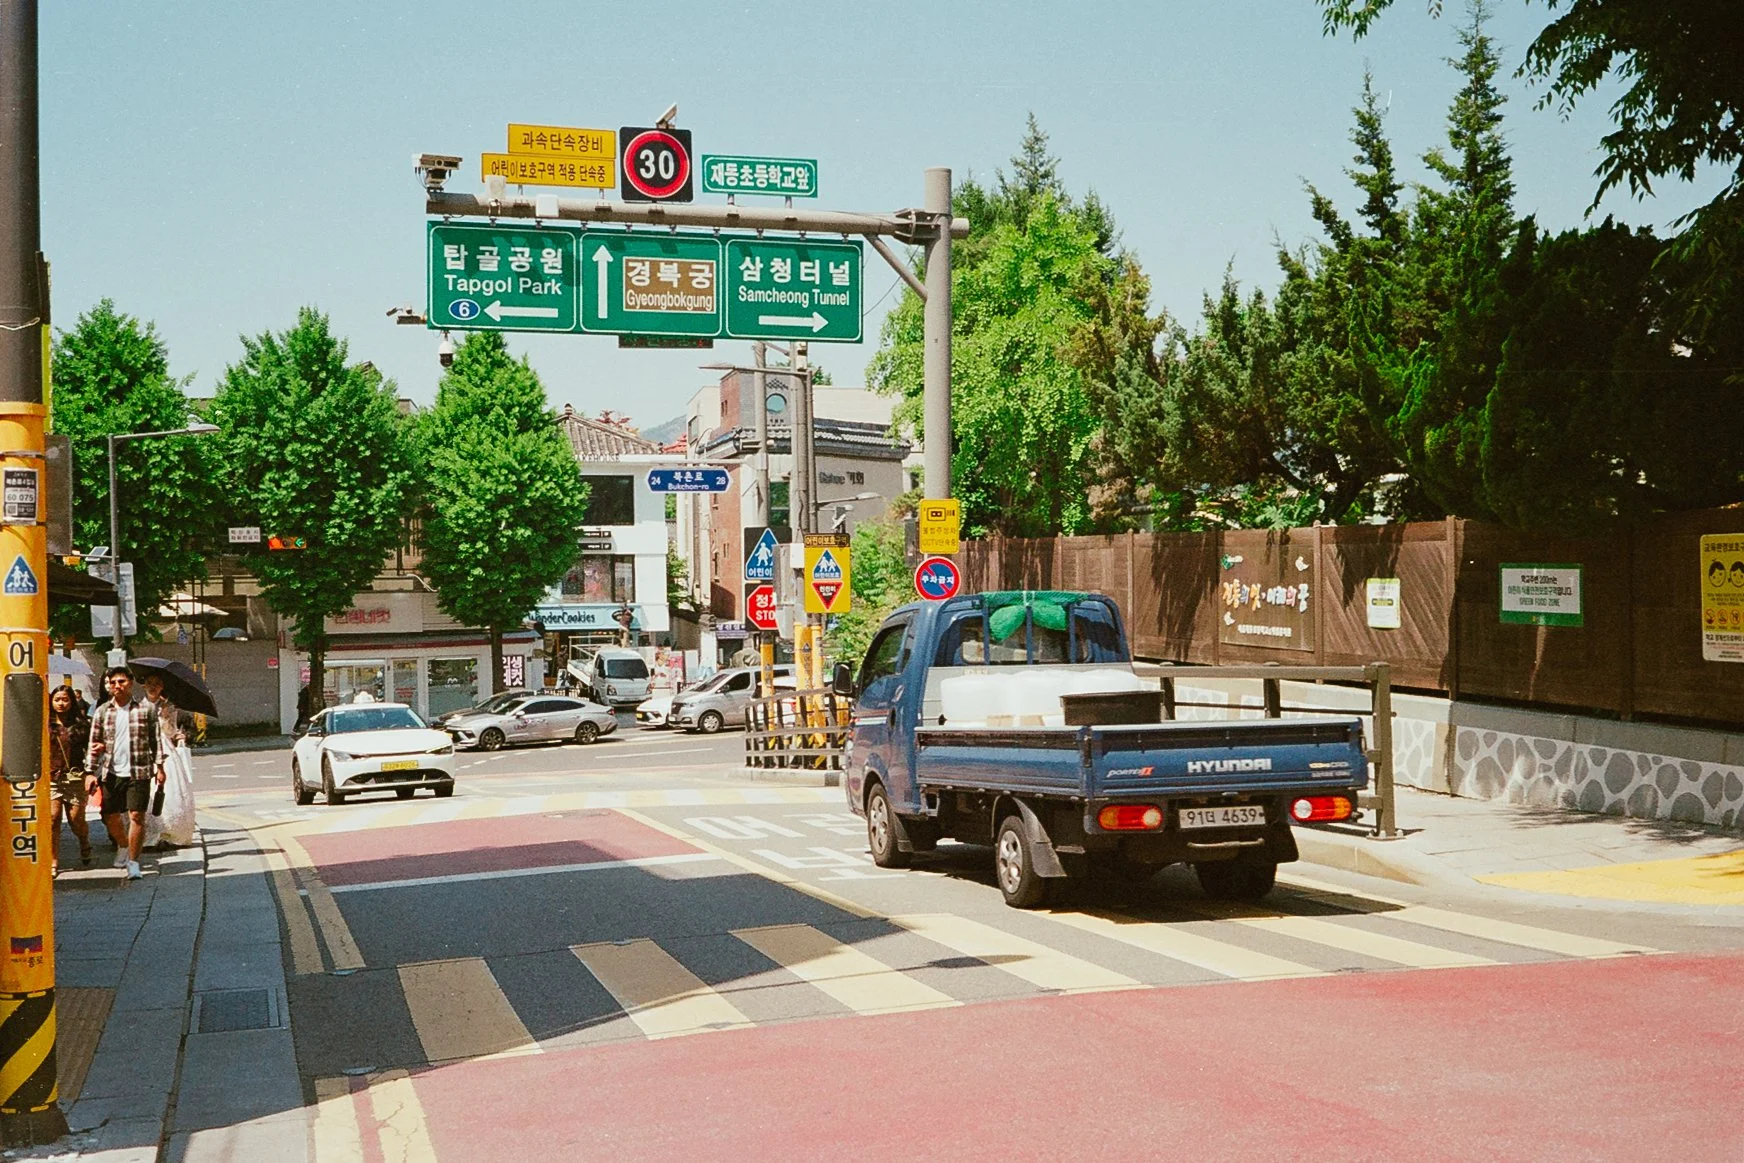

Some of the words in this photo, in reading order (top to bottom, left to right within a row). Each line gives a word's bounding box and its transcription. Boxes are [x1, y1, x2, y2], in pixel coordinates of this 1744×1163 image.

[522, 131, 603, 153] 과속단속장비
[491, 160, 555, 180] 어린이보호구역
[559, 163, 576, 181] 적용
[579, 165, 606, 183] 단속중
[640, 149, 675, 180] 30
[710, 163, 810, 190] 재동초등학교앞
[443, 244, 563, 274] 탑골공원
[627, 261, 713, 289] 경복궁
[738, 256, 851, 286] 삼청터널
[444, 274, 512, 296] Tapgol
[519, 277, 563, 295] Park
[626, 290, 713, 312] Gyeongbokgung
[738, 285, 810, 308] Samcheong
[812, 289, 851, 307] Tunnel
[458, 302, 471, 317] 6
[651, 476, 661, 485] 24
[667, 482, 710, 490] Bukchon-ro
[716, 476, 726, 485] 28
[19, 493, 34, 501] 075
[748, 567, 773, 577] 어린이
[756, 609, 776, 621] STO
[1187, 758, 1272, 773] HYUNDAI
[1222, 808, 1257, 824] 4639
